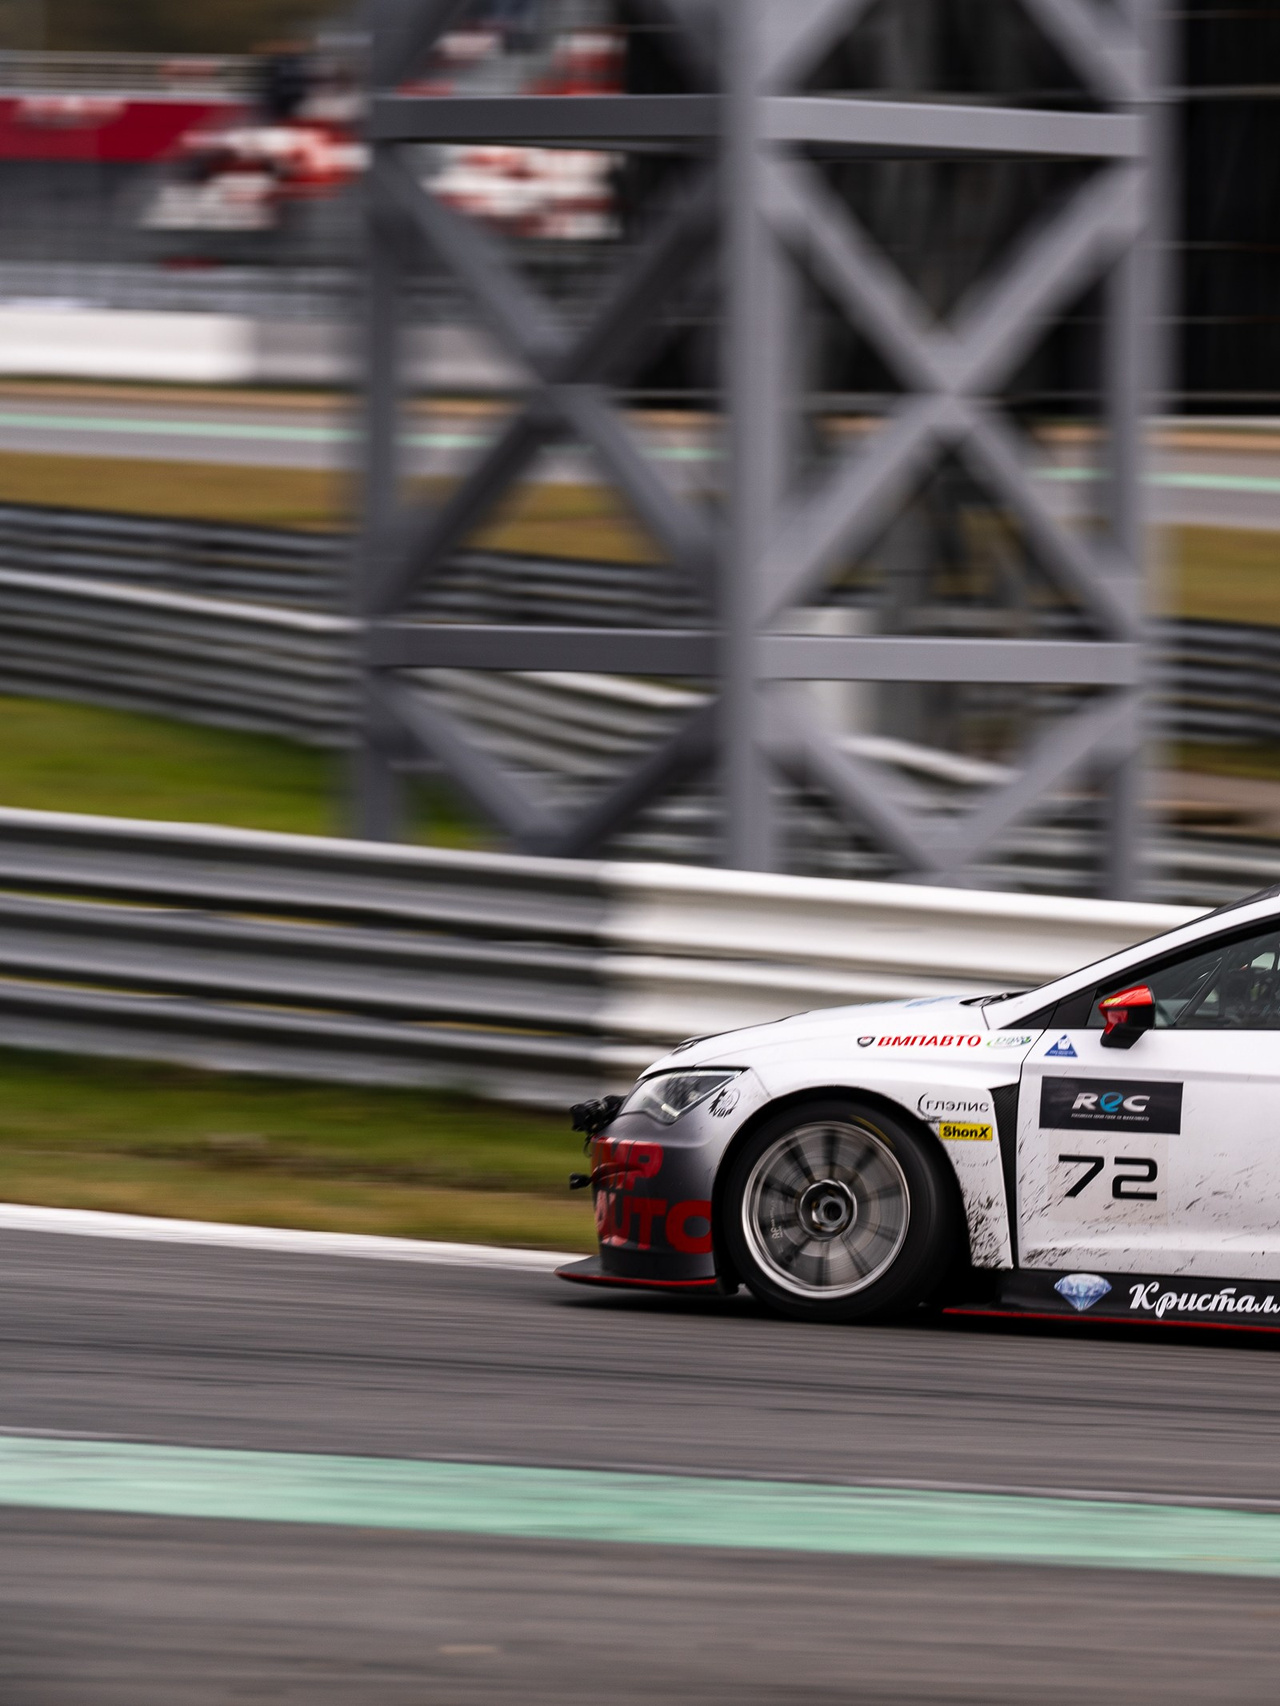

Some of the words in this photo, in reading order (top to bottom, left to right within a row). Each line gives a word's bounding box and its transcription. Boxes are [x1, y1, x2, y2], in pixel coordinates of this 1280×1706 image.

[878, 1035, 982, 1047] ВМПАВТО
[943, 1125, 991, 1138] ShonX
[1058, 1153, 1158, 1201] 72
